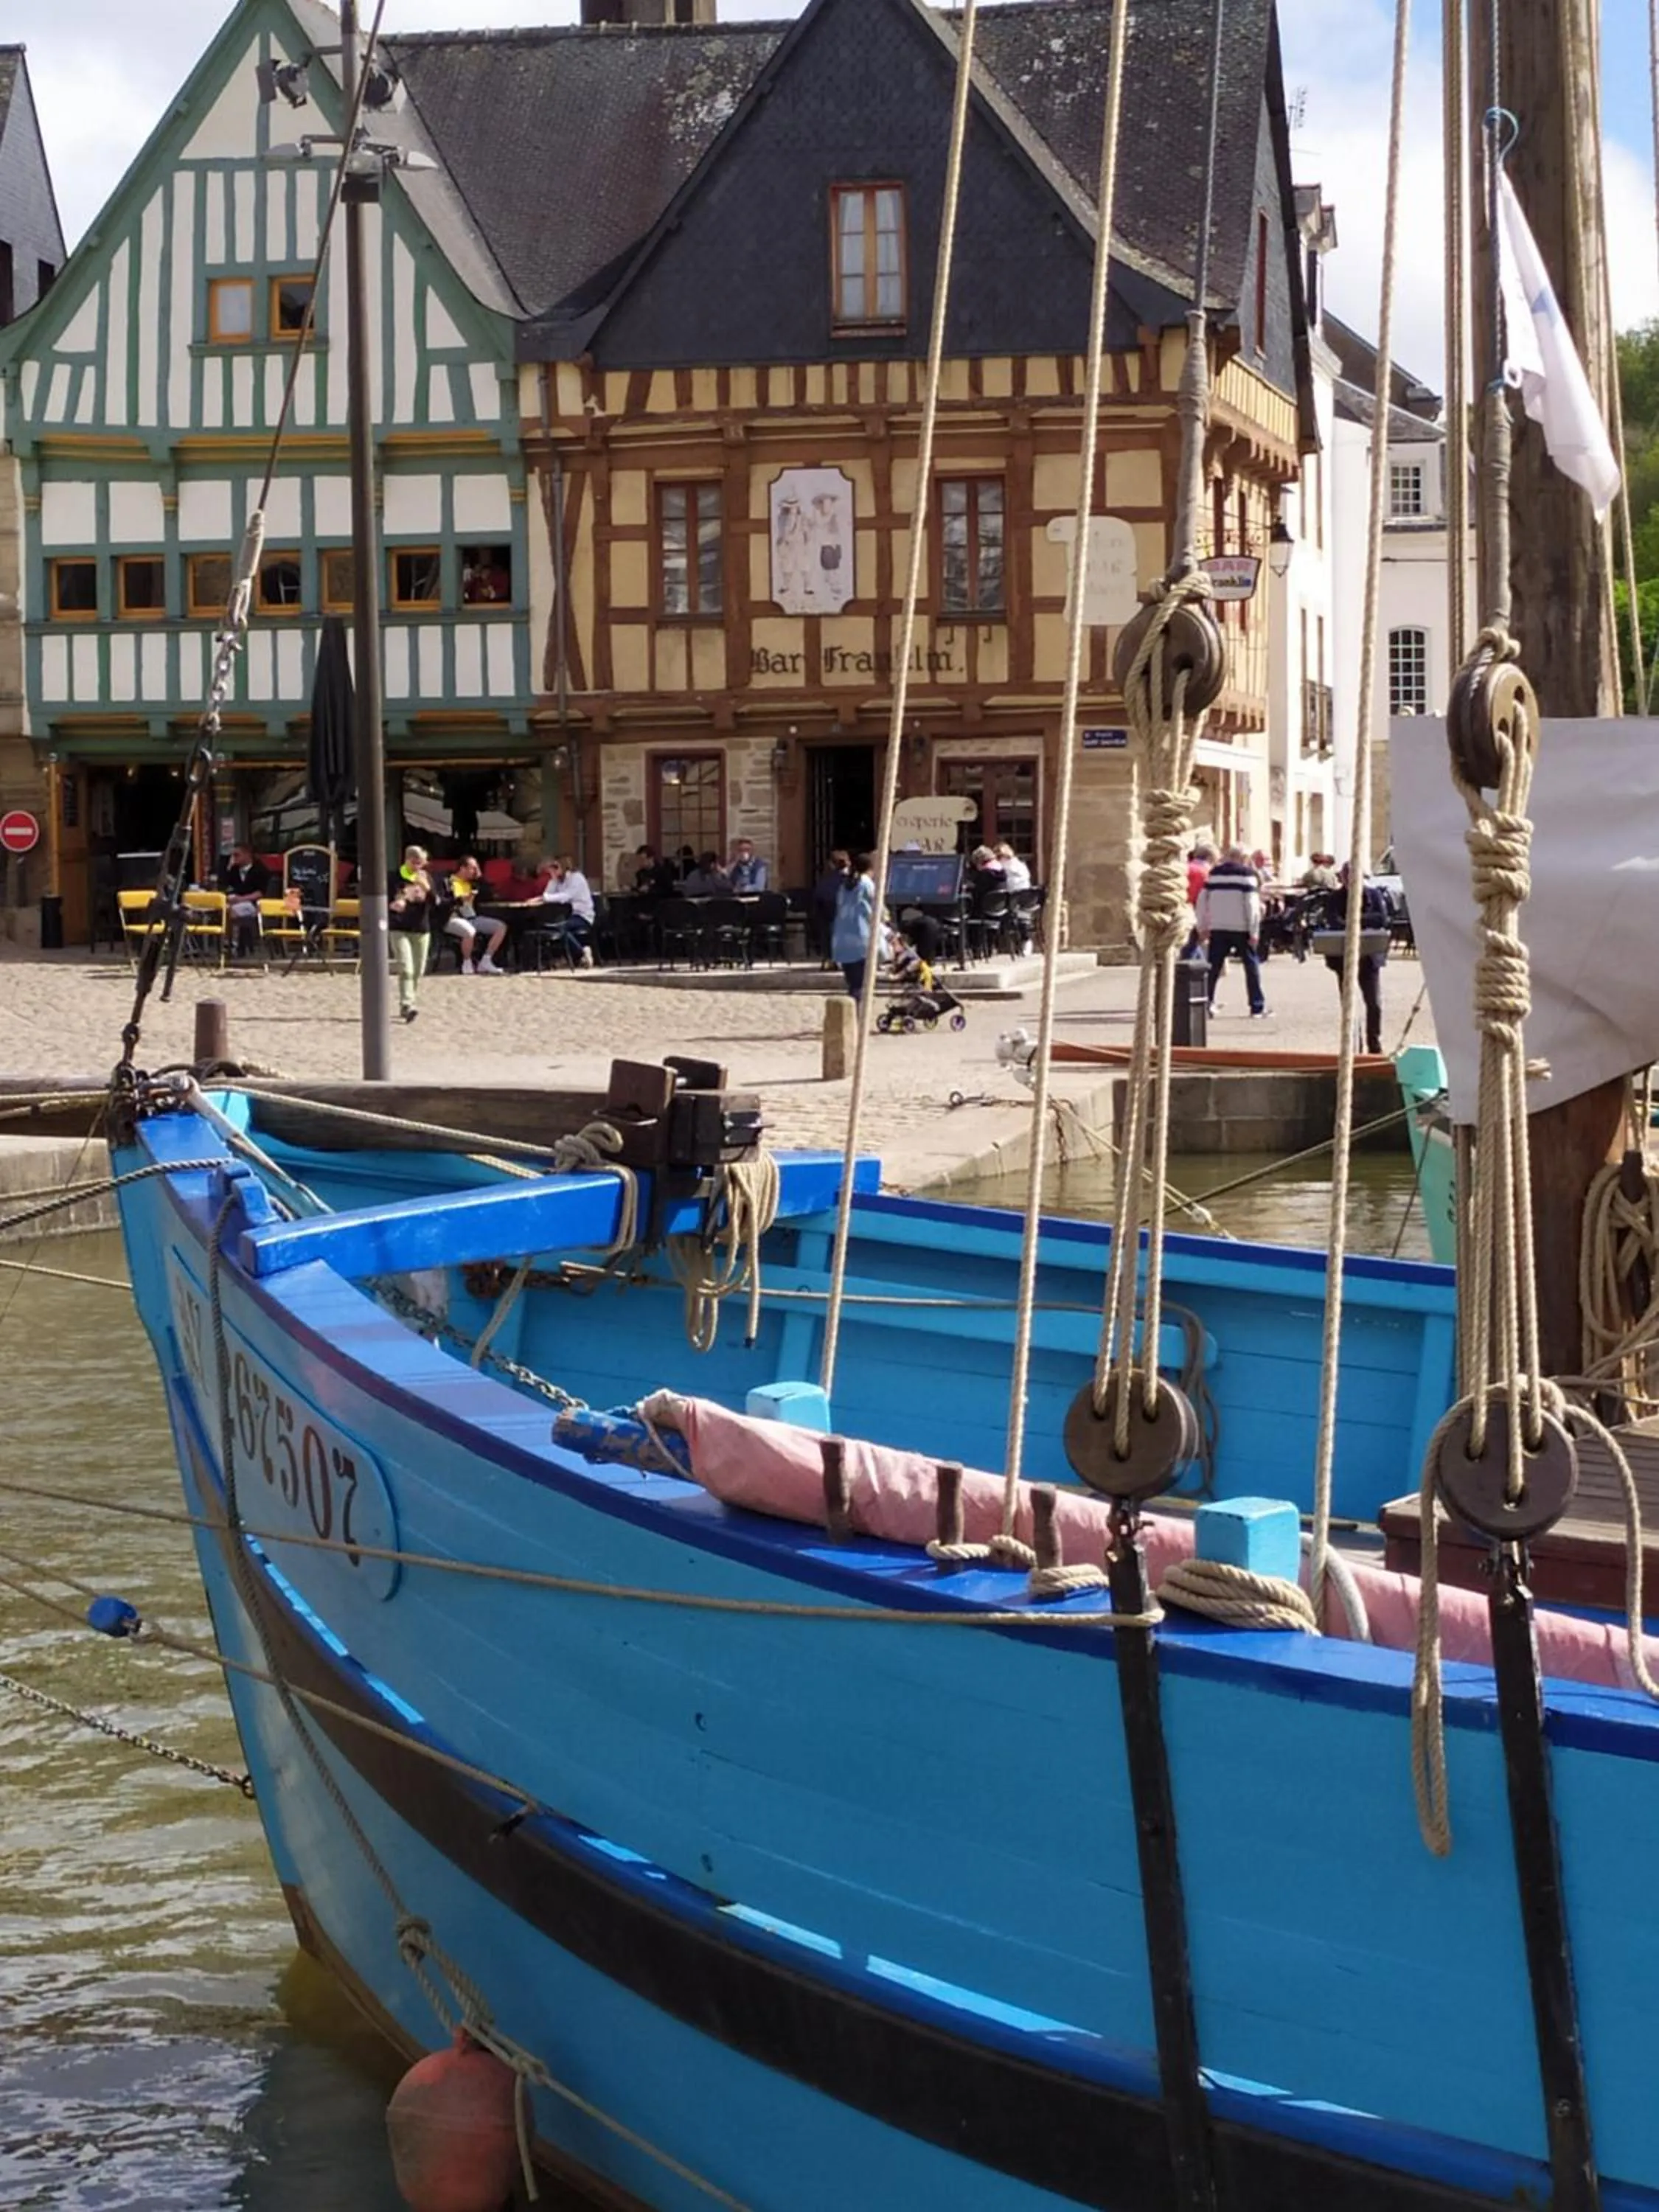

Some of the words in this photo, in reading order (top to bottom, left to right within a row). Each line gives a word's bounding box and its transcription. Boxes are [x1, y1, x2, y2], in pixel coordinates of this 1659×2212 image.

[1210, 575, 1251, 588] ranklin
[751, 646, 808, 674] Bar
[910, 838, 945, 852] AR
